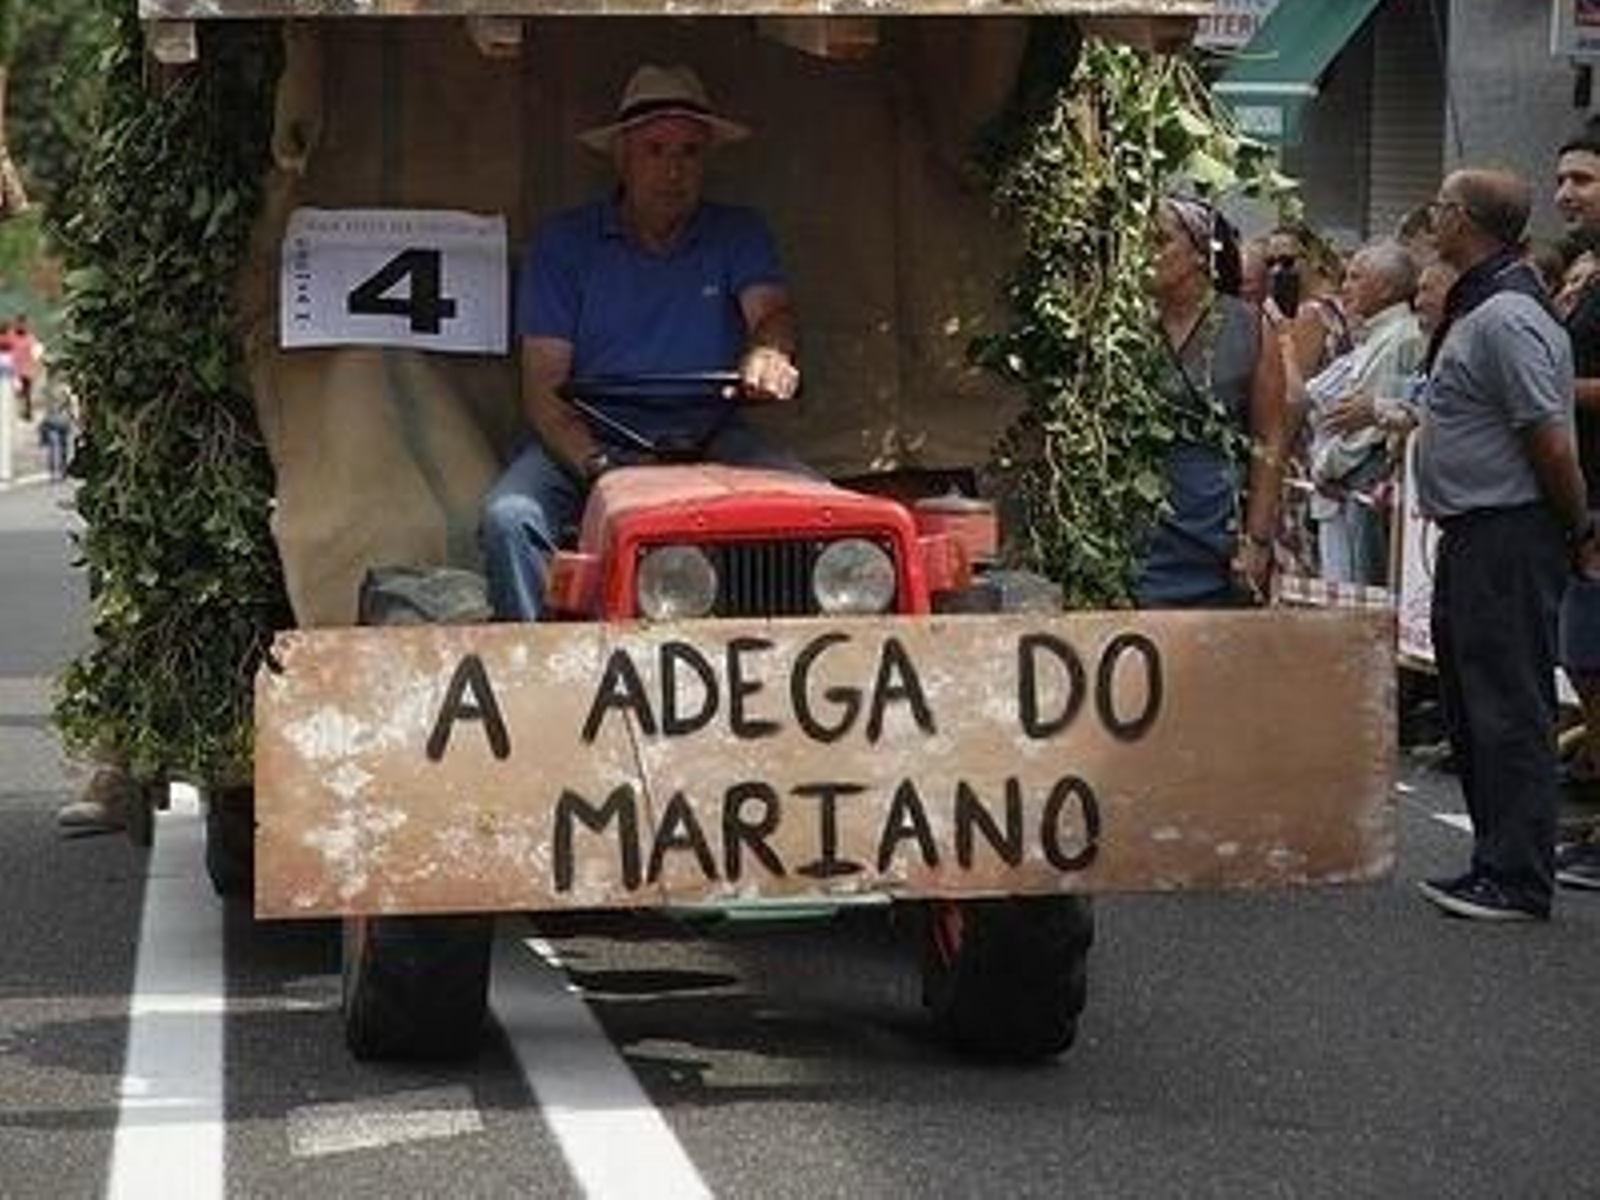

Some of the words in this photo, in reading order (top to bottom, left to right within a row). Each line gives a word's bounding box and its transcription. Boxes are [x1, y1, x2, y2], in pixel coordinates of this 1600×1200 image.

[347, 247, 457, 335] 4
[426, 655, 512, 762] A
[580, 633, 937, 744] ADEGA
[1017, 633, 1164, 744] DO
[551, 775, 1106, 893] MARIANO
